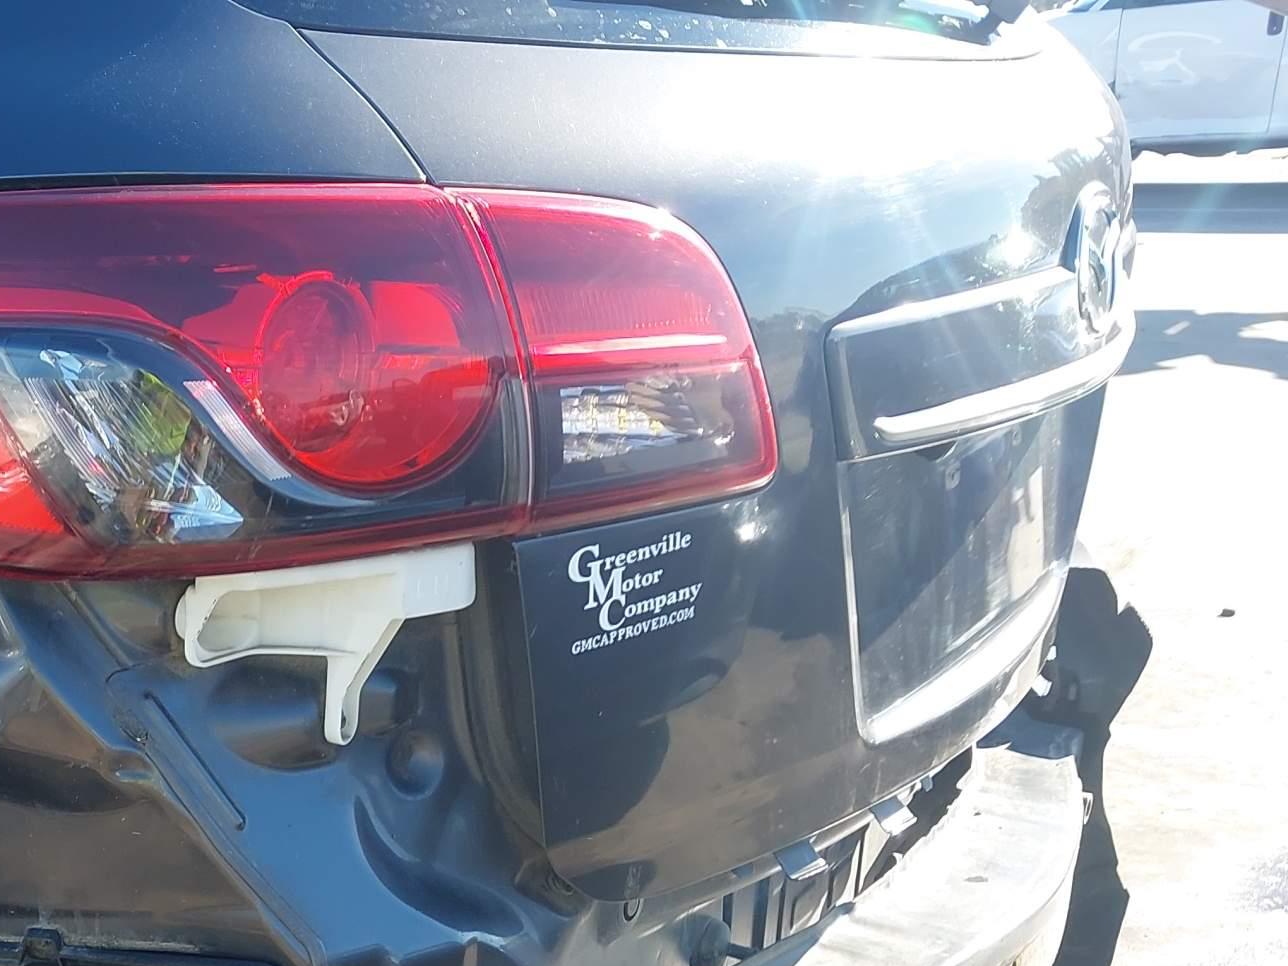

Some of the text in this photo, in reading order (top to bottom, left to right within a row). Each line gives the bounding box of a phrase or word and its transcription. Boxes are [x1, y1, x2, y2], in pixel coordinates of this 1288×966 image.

[568, 531, 692, 583] Greenville
[585, 560, 663, 610] Motor
[599, 583, 703, 631] Company
[571, 605, 695, 655] GMCAPPROVED.COM
